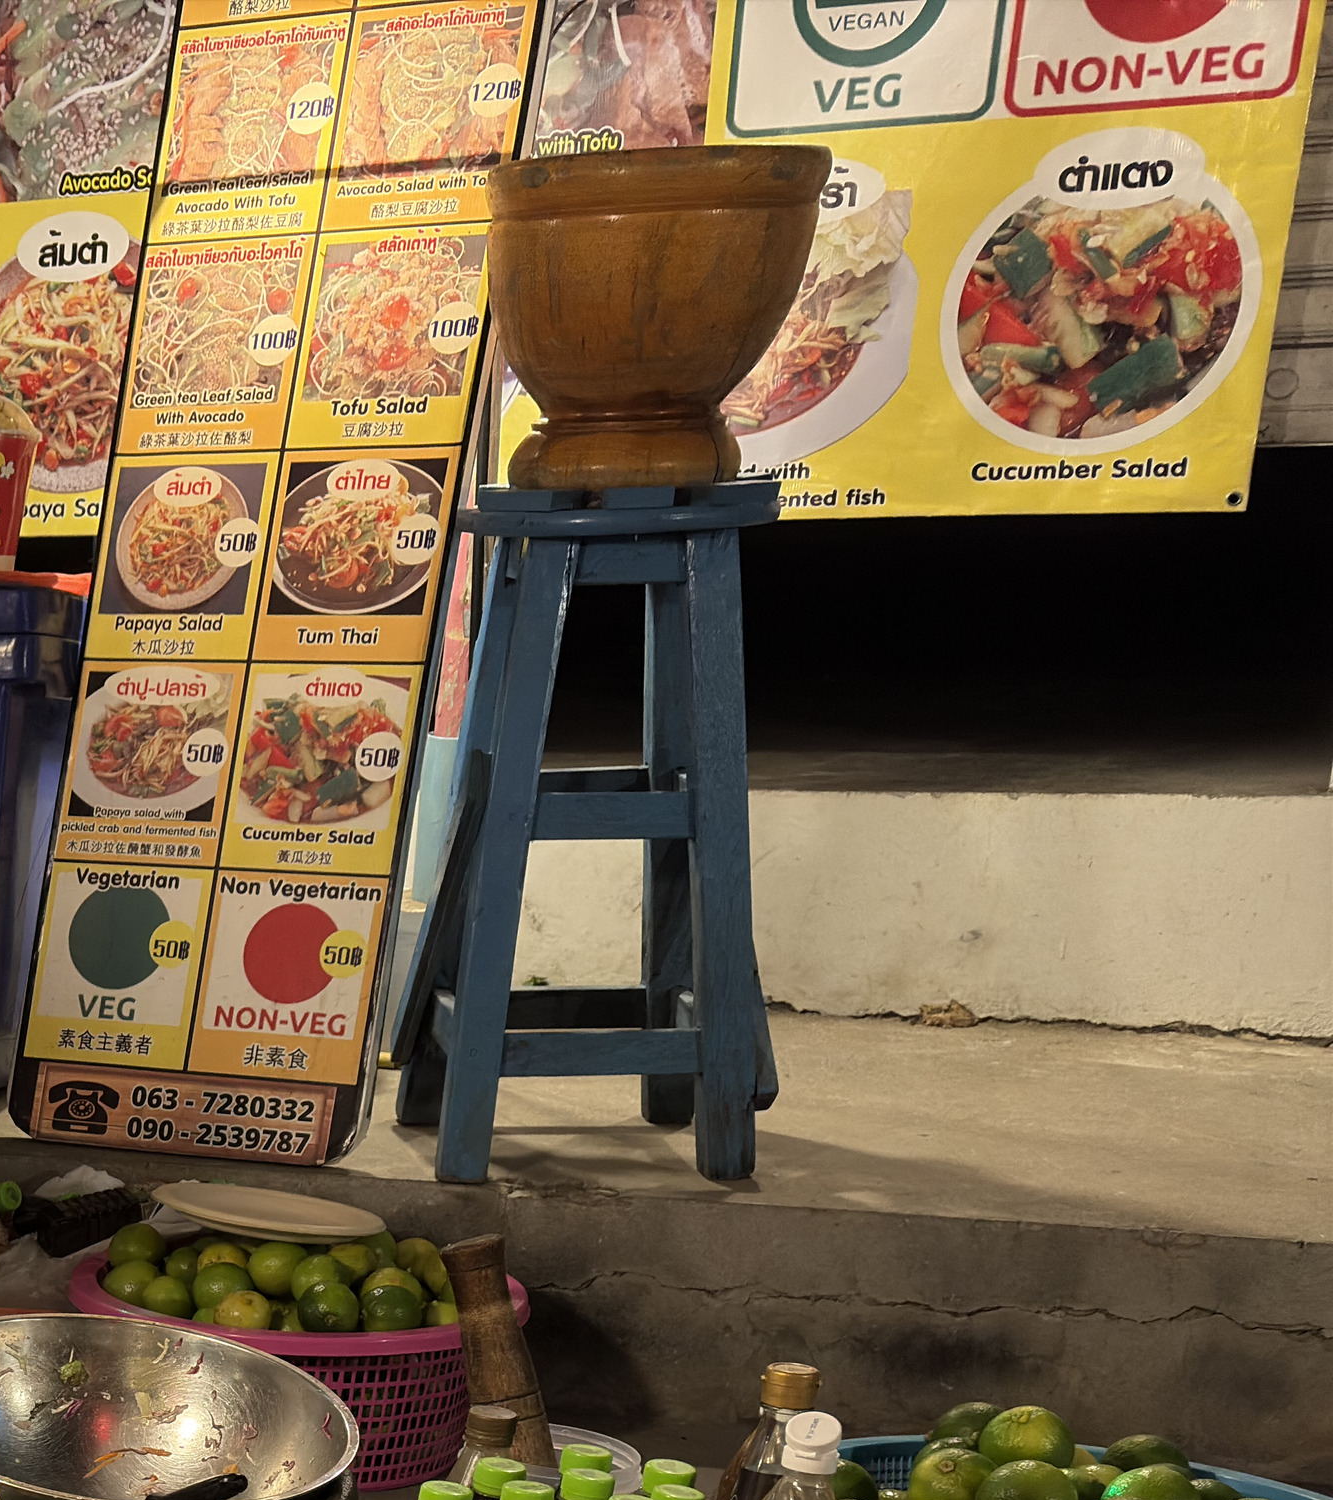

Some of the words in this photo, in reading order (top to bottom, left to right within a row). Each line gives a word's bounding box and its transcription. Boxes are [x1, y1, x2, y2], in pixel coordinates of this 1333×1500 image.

[828, 11, 905, 32] VEGAN
[1032, 43, 1266, 96] NON-VEG
[813, 74, 904, 113] VEG
[539, 135, 575, 155] with
[582, 132, 618, 151] Tofu
[61, 168, 132, 194] Avocado
[169, 180, 209, 197] Green
[271, 172, 310, 187] Salad
[1058, 155, 1173, 192] ตำแตง
[337, 183, 392, 197] Avocado
[396, 178, 434, 193] Salad
[438, 175, 467, 190] with
[176, 198, 229, 215] Avocado
[234, 195, 263, 210] With
[268, 193, 296, 208] Tofu
[370, 198, 458, 219] 酪梨豆腐沙拉
[38, 229, 109, 268] ส้มตำ
[134, 392, 172, 406] Green
[177, 392, 198, 404] tea
[203, 390, 232, 402] Leaf
[235, 387, 274, 401] Salad
[331, 400, 369, 417] Tofu
[375, 396, 428, 415] Salad
[156, 412, 185, 425] With
[188, 410, 244, 424] Avocado
[342, 422, 404, 438] 豆腐沙拉
[335, 468, 390, 491] ตำไทย
[971, 459, 1104, 482] Cucumber
[1111, 456, 1187, 480] Salad
[166, 473, 212, 496] ส้มตำ
[846, 488, 885, 506] fish
[115, 615, 173, 635] Papaya
[178, 614, 223, 632] Salad
[132, 639, 195, 656] 木瓜沙拉
[297, 627, 335, 646] Tum
[340, 627, 379, 645] Thai
[116, 675, 207, 702] ตำปู-ปลาร้า
[305, 676, 363, 698] ตำแตง
[95, 807, 131, 817] Papaya
[134, 808, 161, 818] salad
[163, 810, 184, 819] with
[61, 822, 94, 833] pickled
[98, 824, 119, 833] crab
[123, 825, 142, 833] and
[145, 825, 195, 836] fermented
[199, 827, 216, 838] fish
[242, 825, 323, 845] Cucumber
[327, 828, 375, 846] Salad
[76, 867, 180, 890] Vegetarian
[220, 876, 260, 896] Non
[269, 877, 382, 902] Vegetarian
[78, 993, 137, 1022] VEG
[213, 1005, 347, 1037] NON-VEG
[57, 1029, 153, 1056] 素食主義者
[243, 1043, 309, 1070] 非素食
[132, 1085, 179, 1110] 063
[201, 1090, 315, 1124] 7280332
[126, 1116, 174, 1143] 090
[195, 1122, 311, 1156] 2539787
